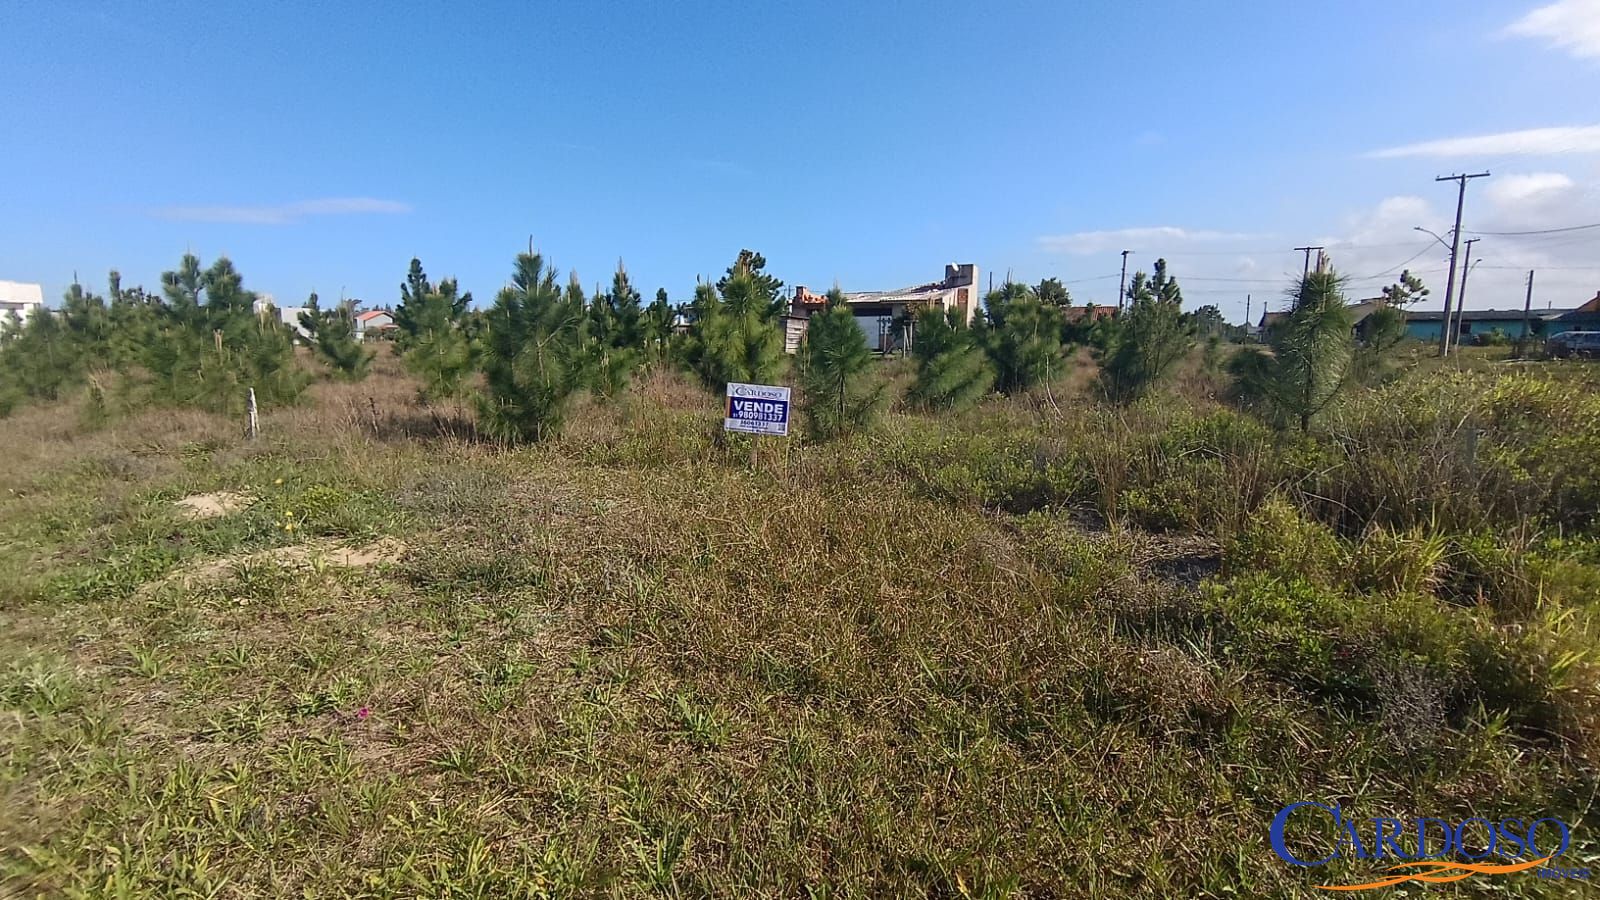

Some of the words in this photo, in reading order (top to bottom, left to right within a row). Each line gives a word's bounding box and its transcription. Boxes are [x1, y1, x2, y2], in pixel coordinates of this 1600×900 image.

[735, 385, 782, 398] CARDOSO
[733, 400, 784, 414] VENDE
[738, 410, 783, 421] 980981337
